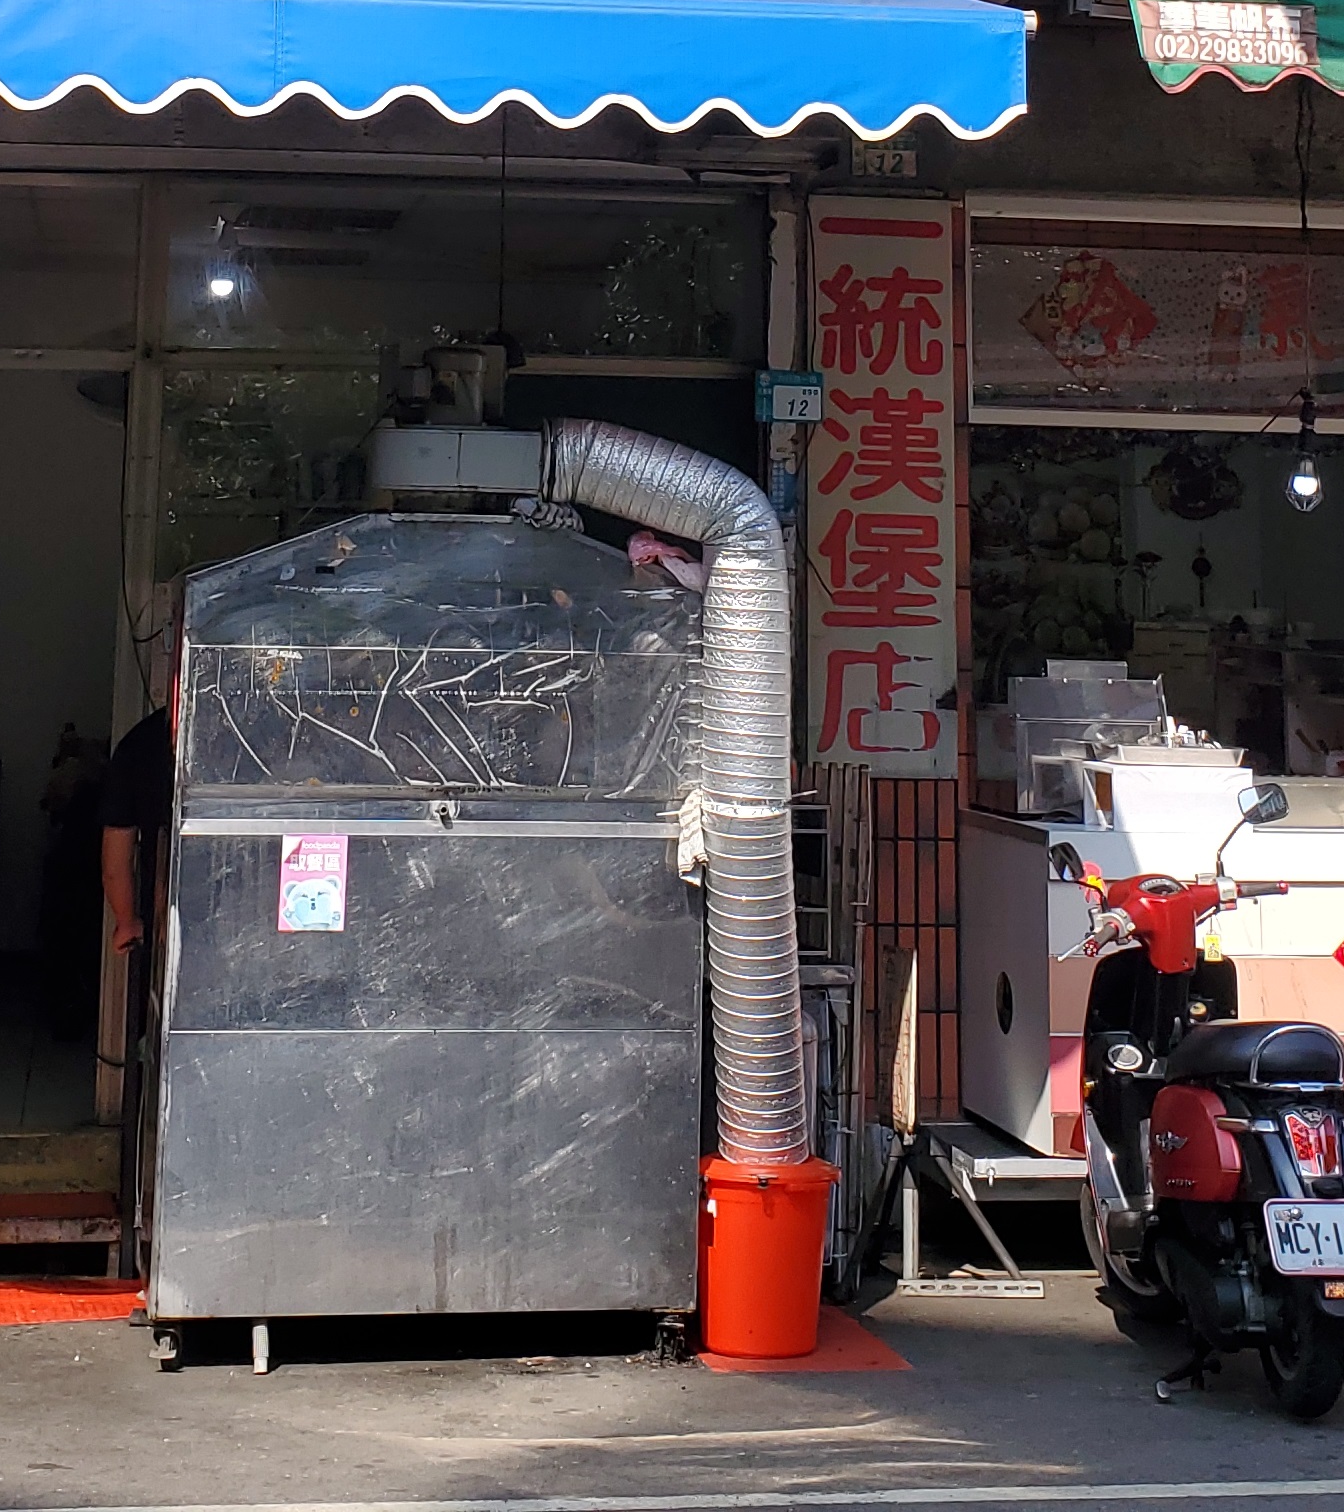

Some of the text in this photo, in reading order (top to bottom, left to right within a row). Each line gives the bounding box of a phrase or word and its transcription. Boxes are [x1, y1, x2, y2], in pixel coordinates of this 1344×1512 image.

[1154, 34, 1309, 65] (02)29833096
[787, 398, 809, 417] 12
[817, 217, 945, 754] 一統漢堡店
